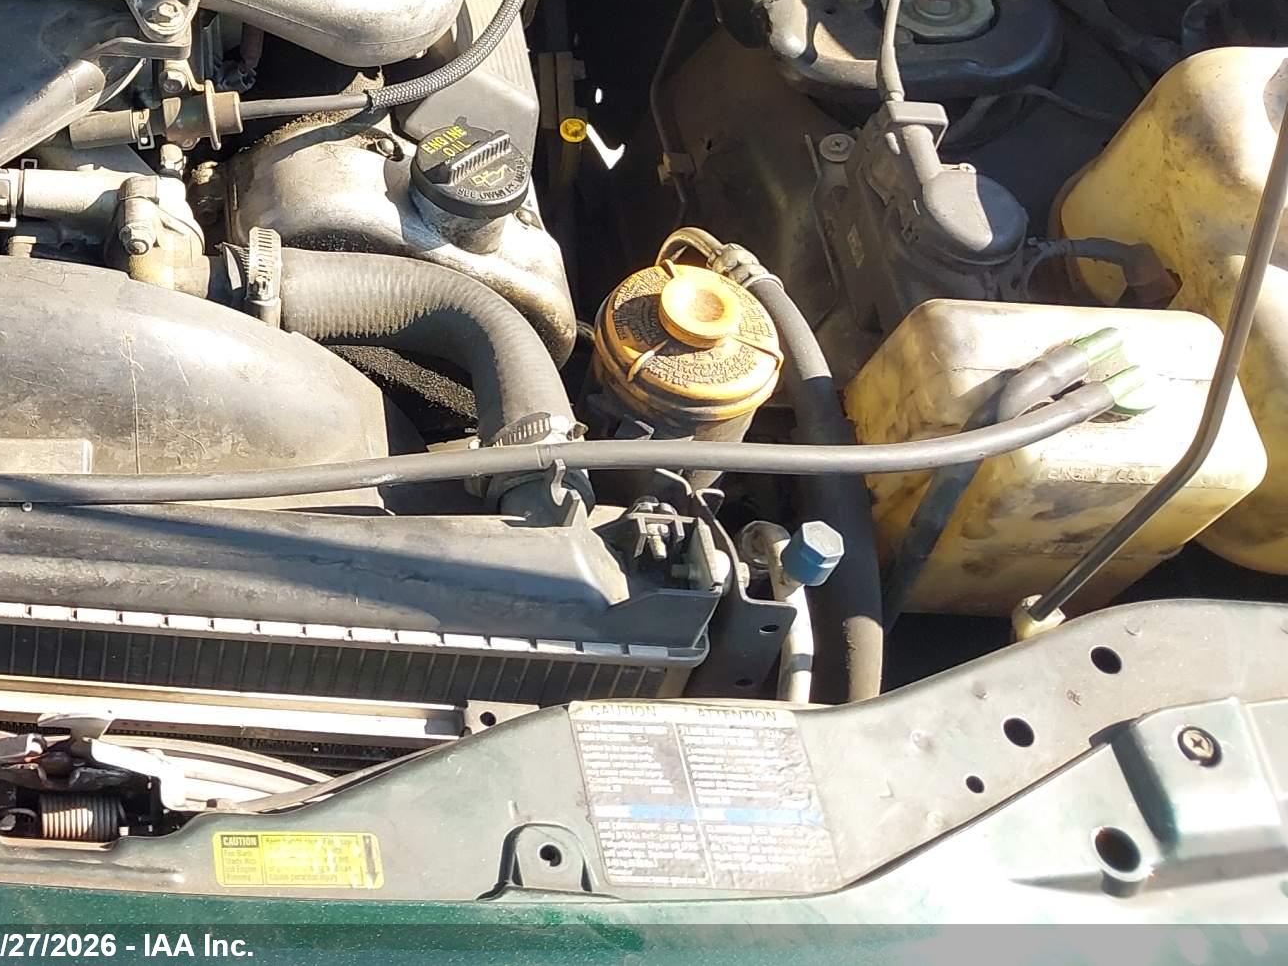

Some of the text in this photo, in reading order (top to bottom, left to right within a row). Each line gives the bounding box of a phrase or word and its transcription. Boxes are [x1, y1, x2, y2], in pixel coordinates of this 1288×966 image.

[420, 125, 468, 155] ENGINE
[442, 140, 472, 157] OIL
[591, 706, 776, 721] CAUTION ATTENTION
[222, 836, 257, 846] CAUTION
